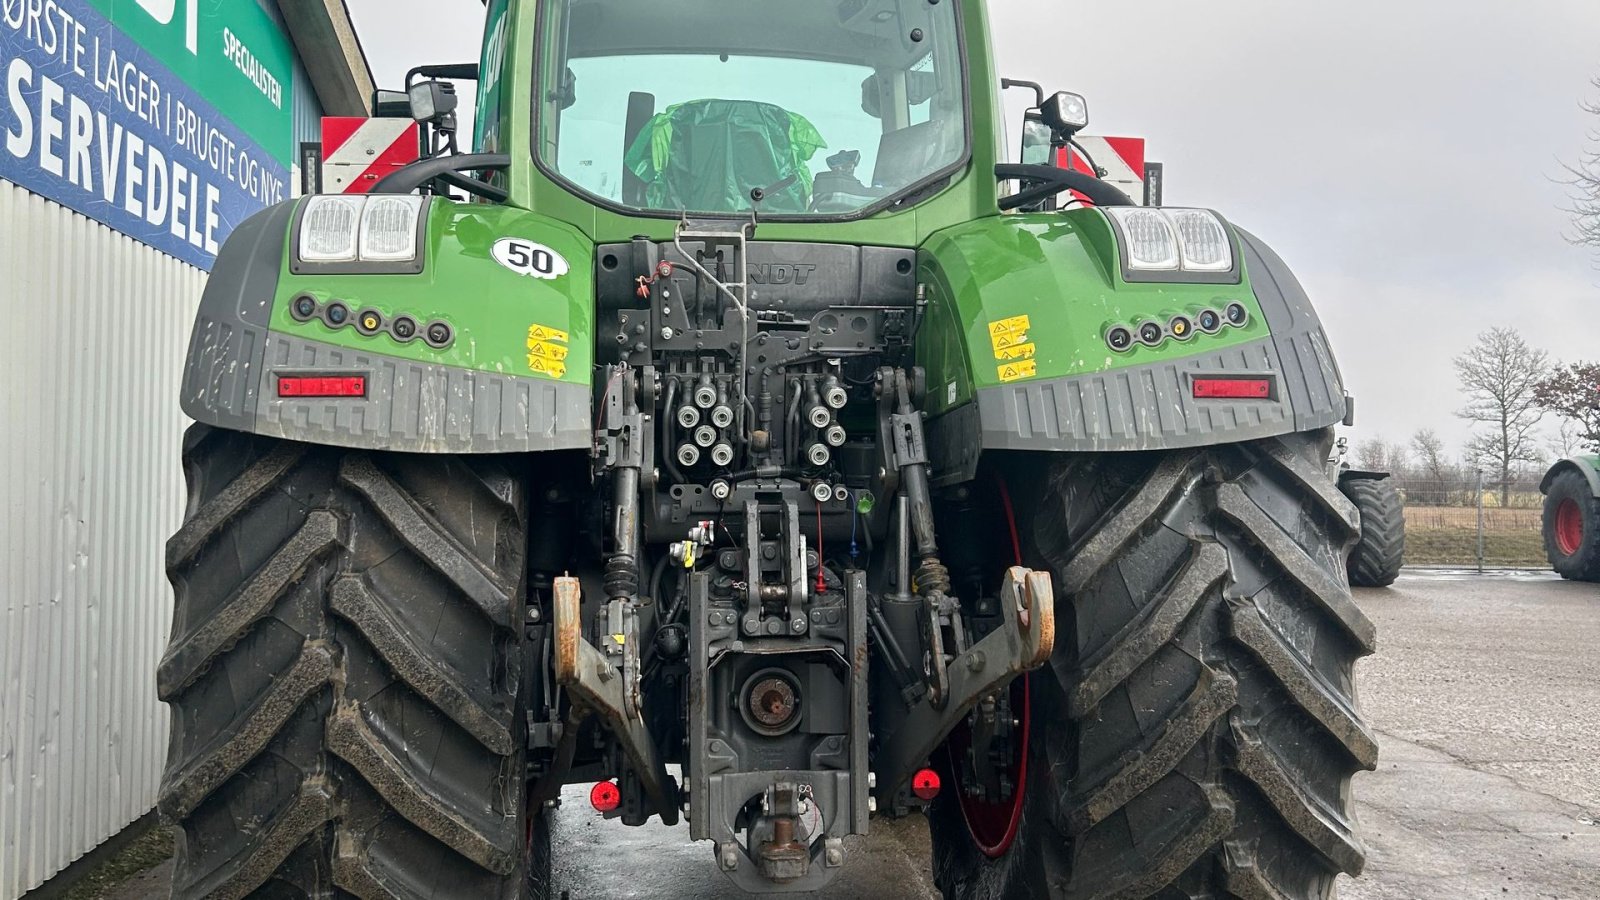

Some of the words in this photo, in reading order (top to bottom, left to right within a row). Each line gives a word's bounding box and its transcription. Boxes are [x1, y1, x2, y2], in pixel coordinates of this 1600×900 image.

[94, 36, 160, 130] LAGER
[166, 93, 171, 136] I
[176, 98, 235, 182] BRUGTE
[238, 150, 258, 197] OG
[222, 27, 282, 110] SPECIALISTEN
[6, 58, 221, 256] SERVEDELE
[507, 242, 555, 275] 50
